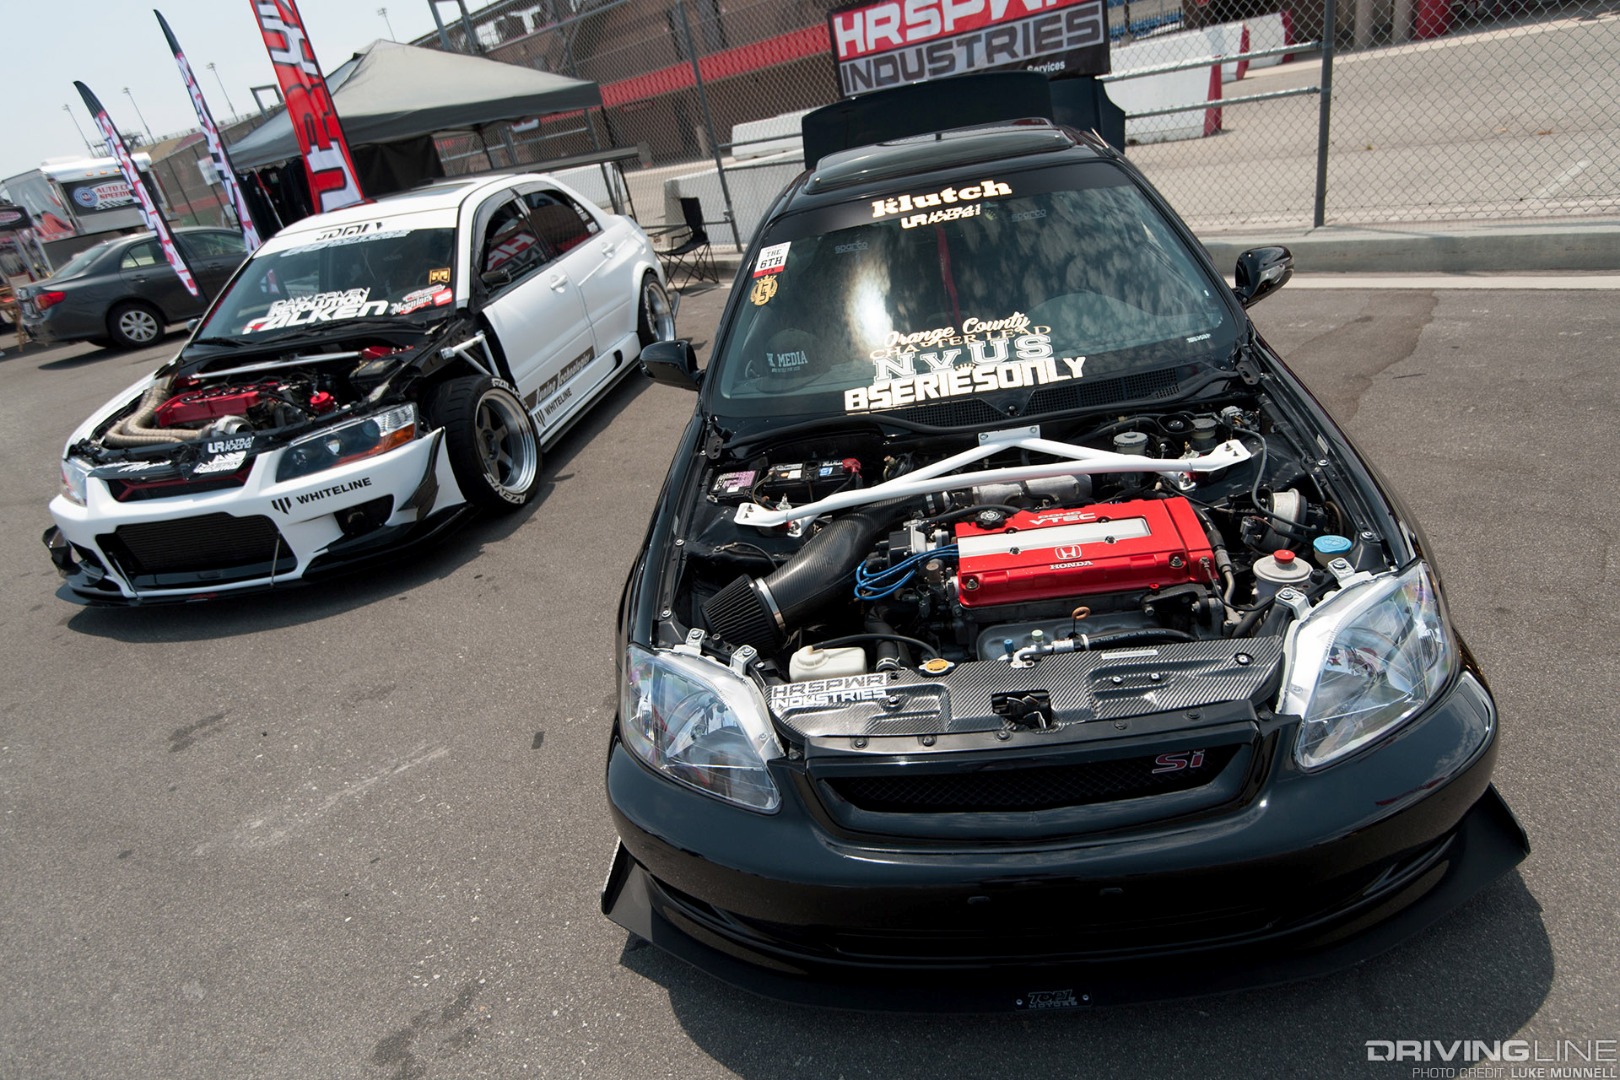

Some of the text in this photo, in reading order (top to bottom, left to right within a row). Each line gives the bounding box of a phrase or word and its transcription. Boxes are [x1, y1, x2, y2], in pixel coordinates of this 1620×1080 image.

[841, 5, 1101, 94] INDUSTRIES
[760, 256, 783, 269] 6TH
[884, 311, 1031, 348] Orange County
[777, 350, 808, 368] MEDIA
[844, 356, 1087, 411] BSERIESONLY
[544, 387, 573, 416] WHITELINE
[297, 477, 372, 505] WHITELINE
[1029, 512, 1096, 525] VTEC
[1050, 560, 1093, 570] HONDA
[773, 674, 885, 698] HRSPWR
[771, 689, 887, 709] INDUSTRIES
[1152, 749, 1205, 774] Si
